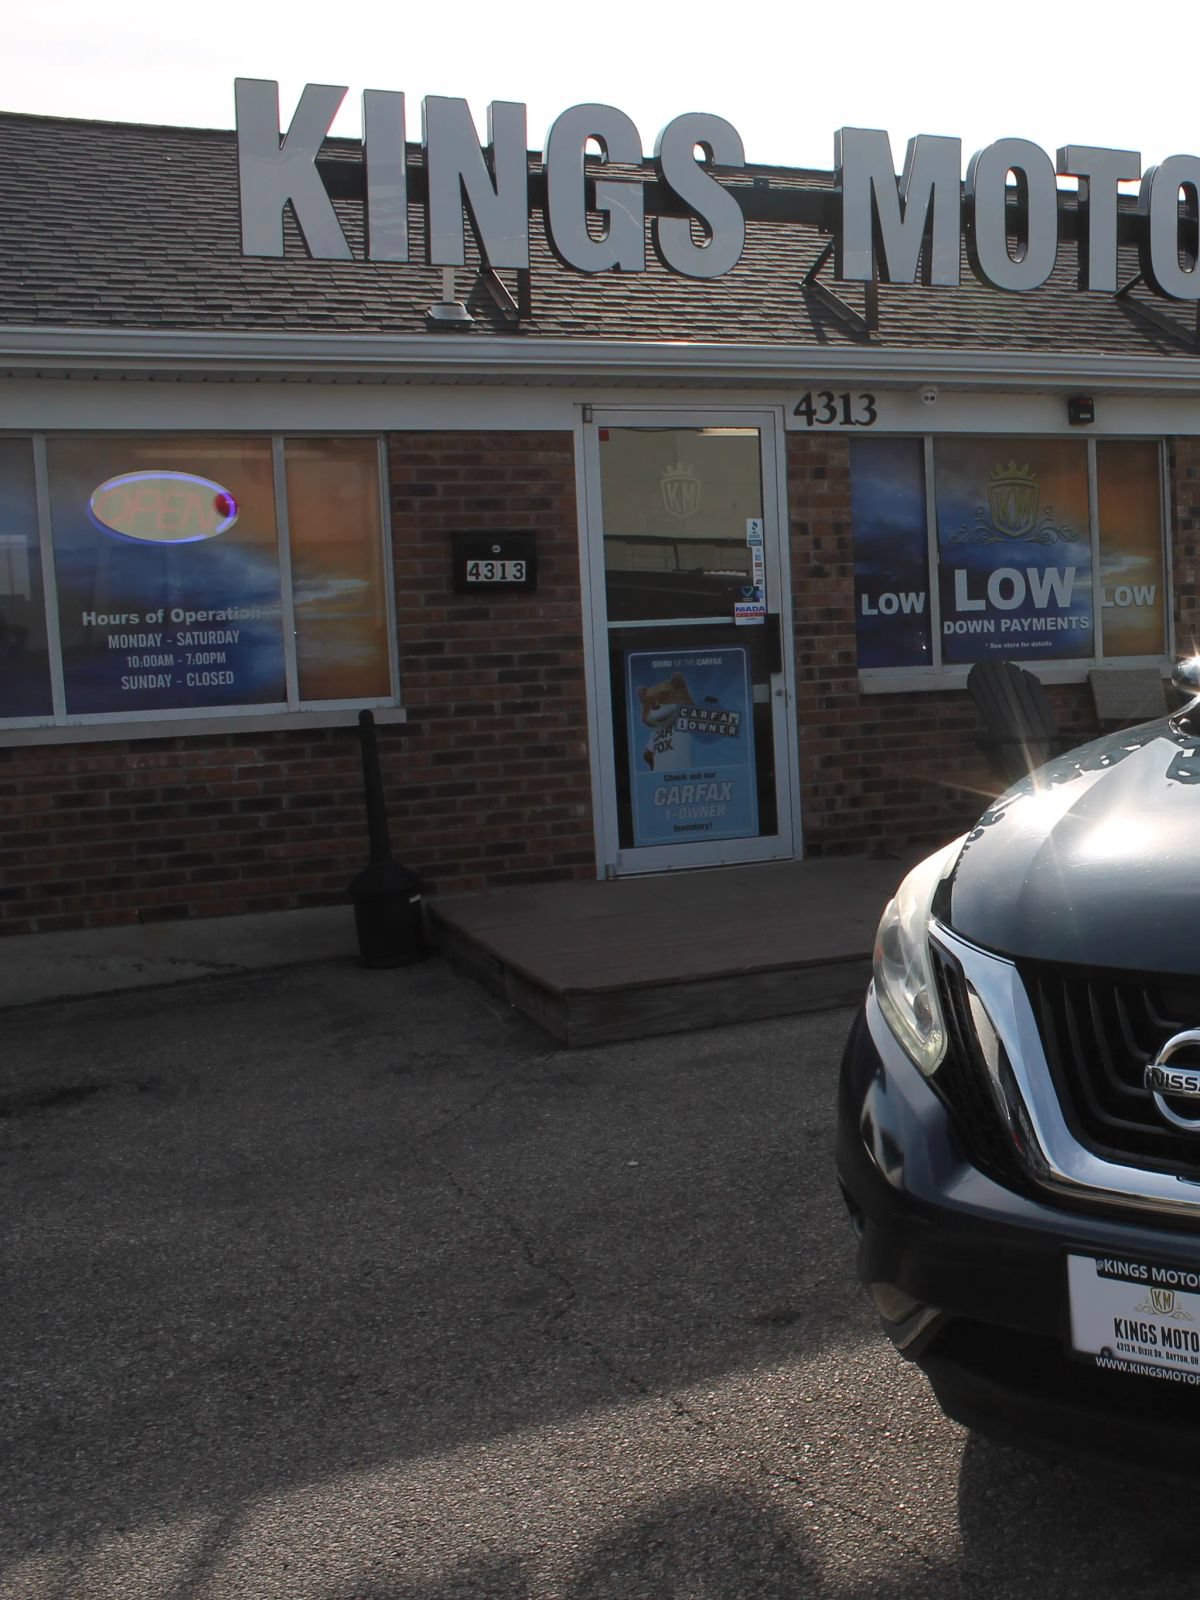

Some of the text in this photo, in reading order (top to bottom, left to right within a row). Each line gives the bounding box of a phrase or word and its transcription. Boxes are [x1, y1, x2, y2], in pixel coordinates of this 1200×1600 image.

[234, 77, 745, 279] KINGS
[793, 390, 878, 427] 4313
[95, 486, 218, 530] OPEN
[468, 562, 525, 580] 4313
[954, 567, 1076, 611] LOW
[1101, 585, 1156, 608] LOW
[735, 605, 766, 613] NIADA
[861, 592, 925, 616] LOW
[82, 607, 261, 626] Hours of Operation
[944, 616, 1089, 634] DOWN PAYMENTS
[108, 633, 162, 649] MONDAY
[176, 630, 240, 646] SATURDAY
[126, 654, 174, 668] 10:00AM
[186, 652, 226, 665] 7:00PM
[652, 660, 672, 668] SHOW
[696, 657, 723, 666] CARFAX
[121, 674, 172, 690] SUNDAY
[186, 671, 235, 687] CLOSED
[681, 708, 739, 724] CARFAX
[689, 721, 736, 735] OWNER
[664, 773, 687, 782] Check
[654, 781, 734, 806] CARFAX
[666, 804, 727, 820] 1-OWNER
[1103, 1259, 1148, 1278] KINGS
[1153, 1290, 1171, 1312] KM
[1114, 1318, 1157, 1345] KINGS
[1116, 1342, 1130, 1352] 4313
[1191, 1356, 1199, 1366] OH
